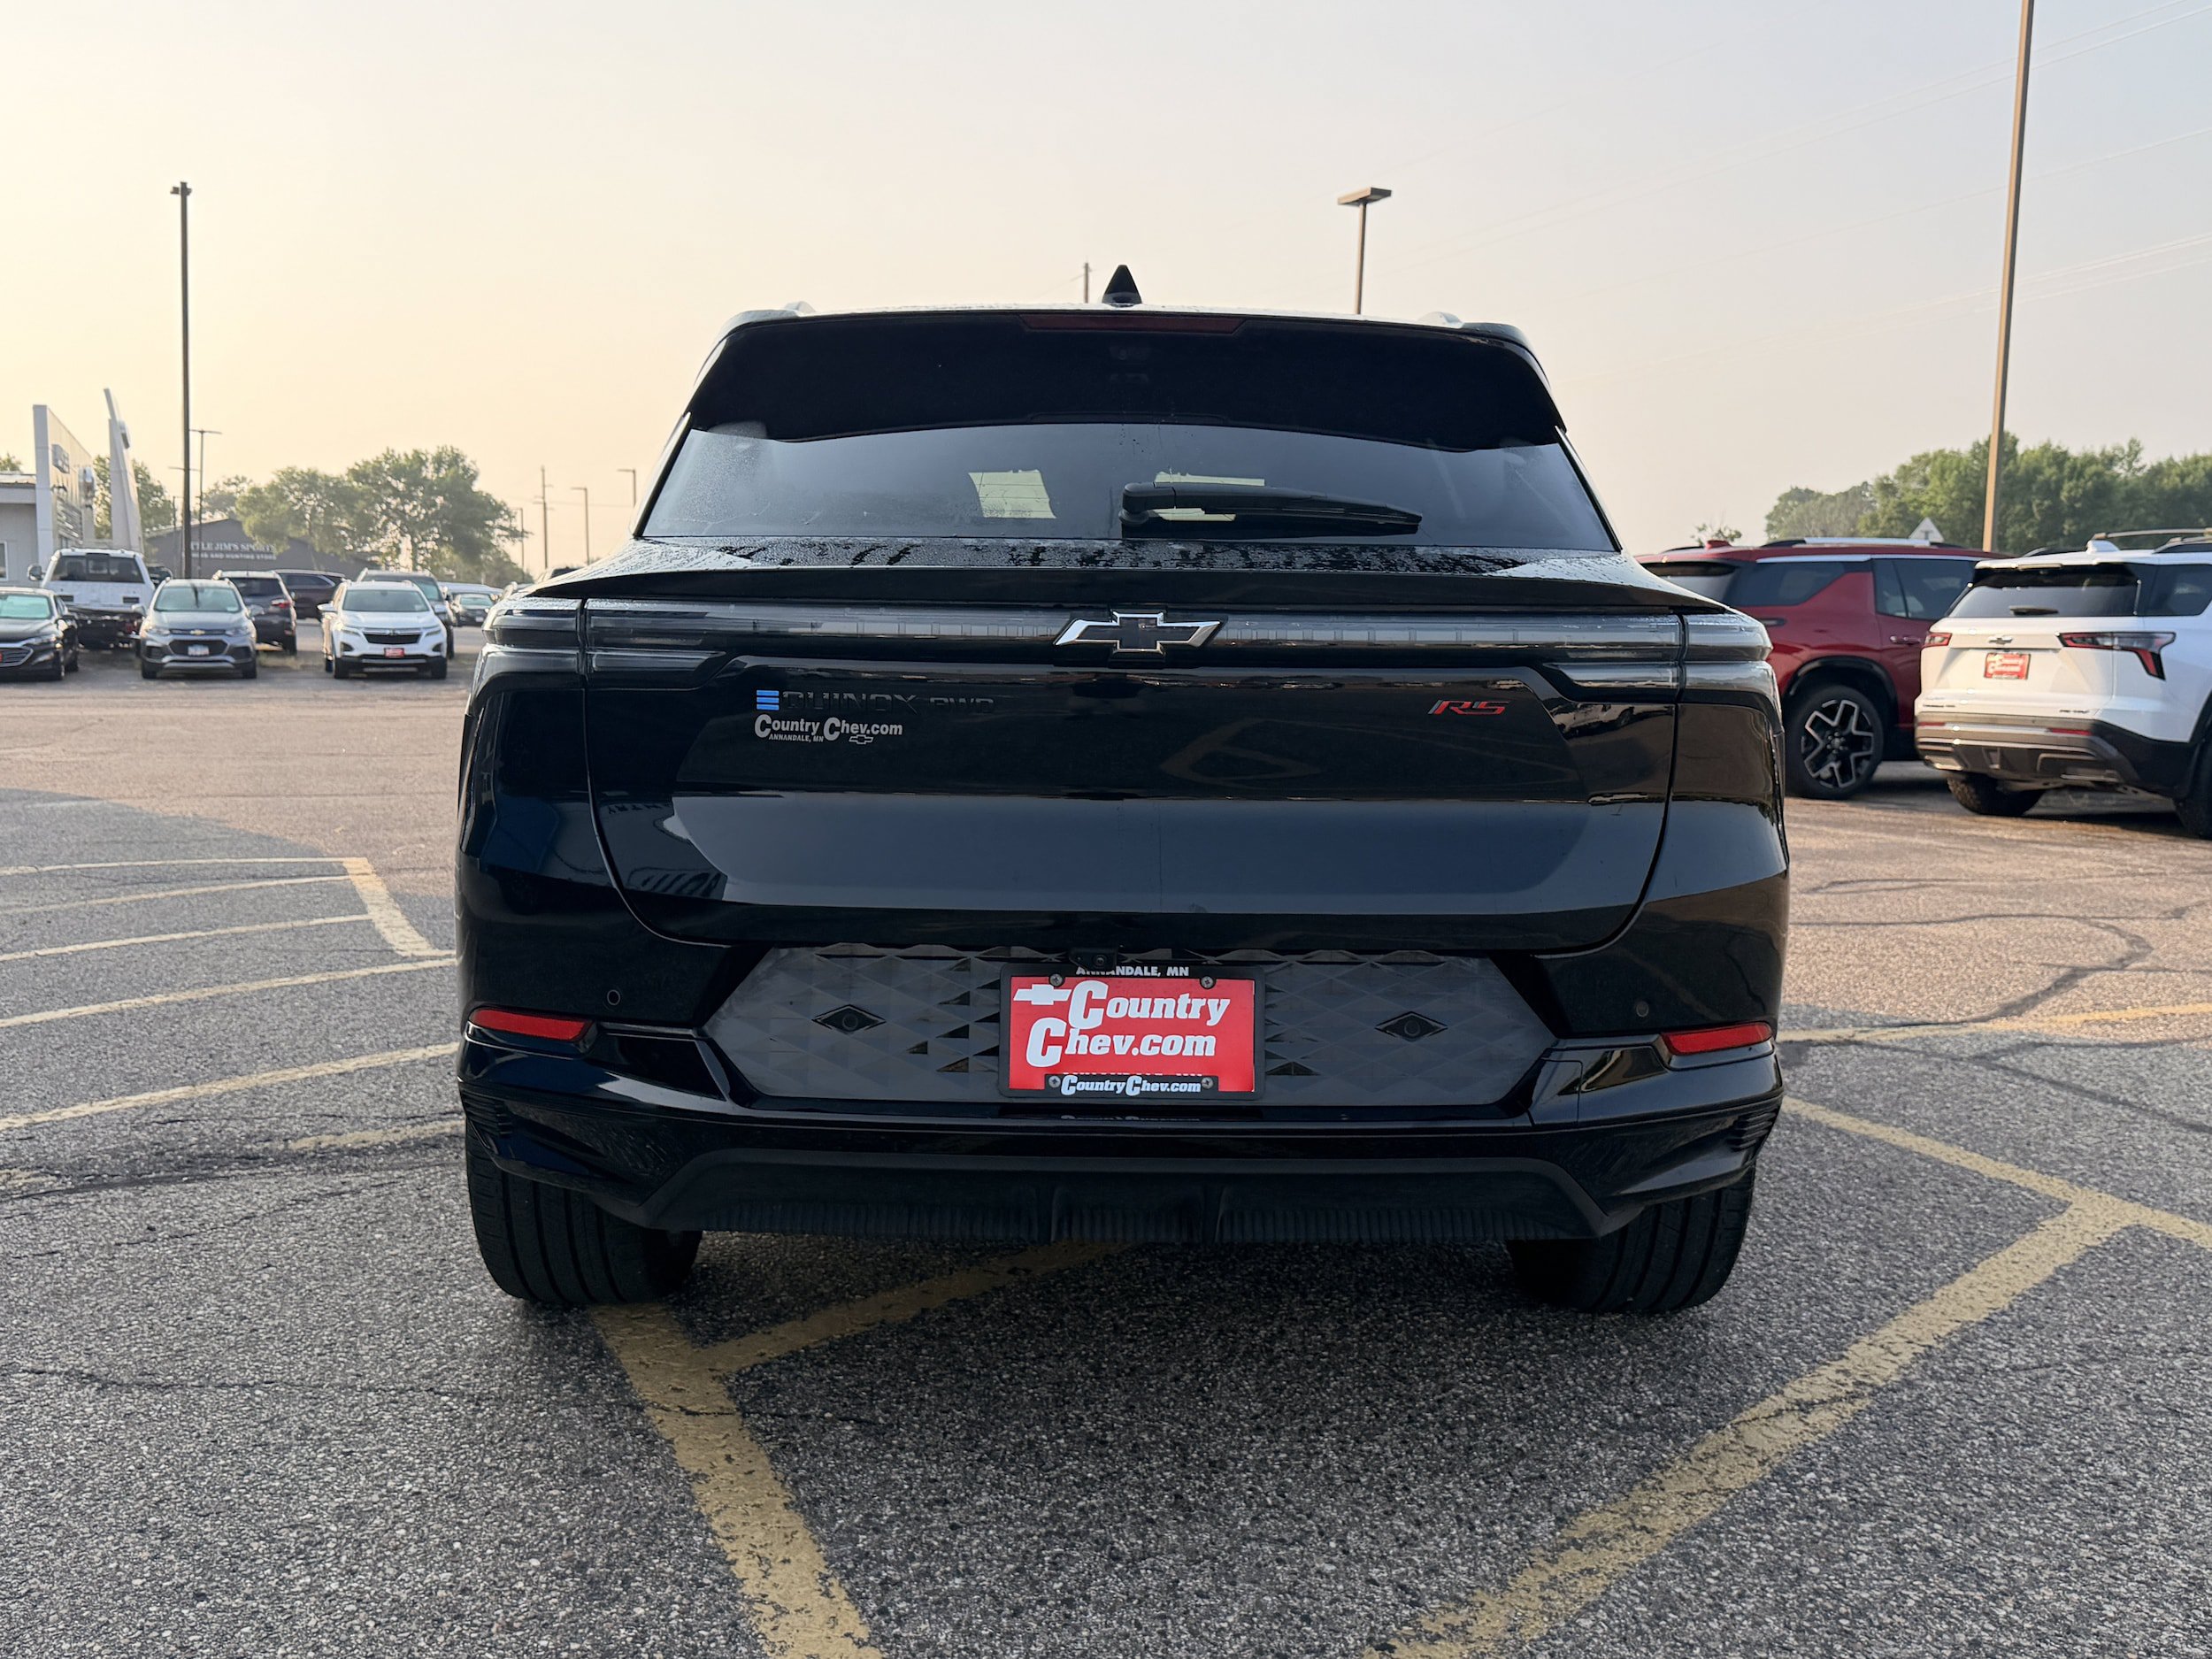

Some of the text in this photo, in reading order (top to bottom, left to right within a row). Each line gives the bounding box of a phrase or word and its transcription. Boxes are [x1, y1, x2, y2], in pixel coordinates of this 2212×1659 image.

[1428, 699, 1510, 715] RS
[768, 733, 811, 743] ANNANDALE,
[1166, 966, 1189, 977] MN
[1068, 979, 1230, 1030] Country
[1025, 1017, 1217, 1068] Chev.com
